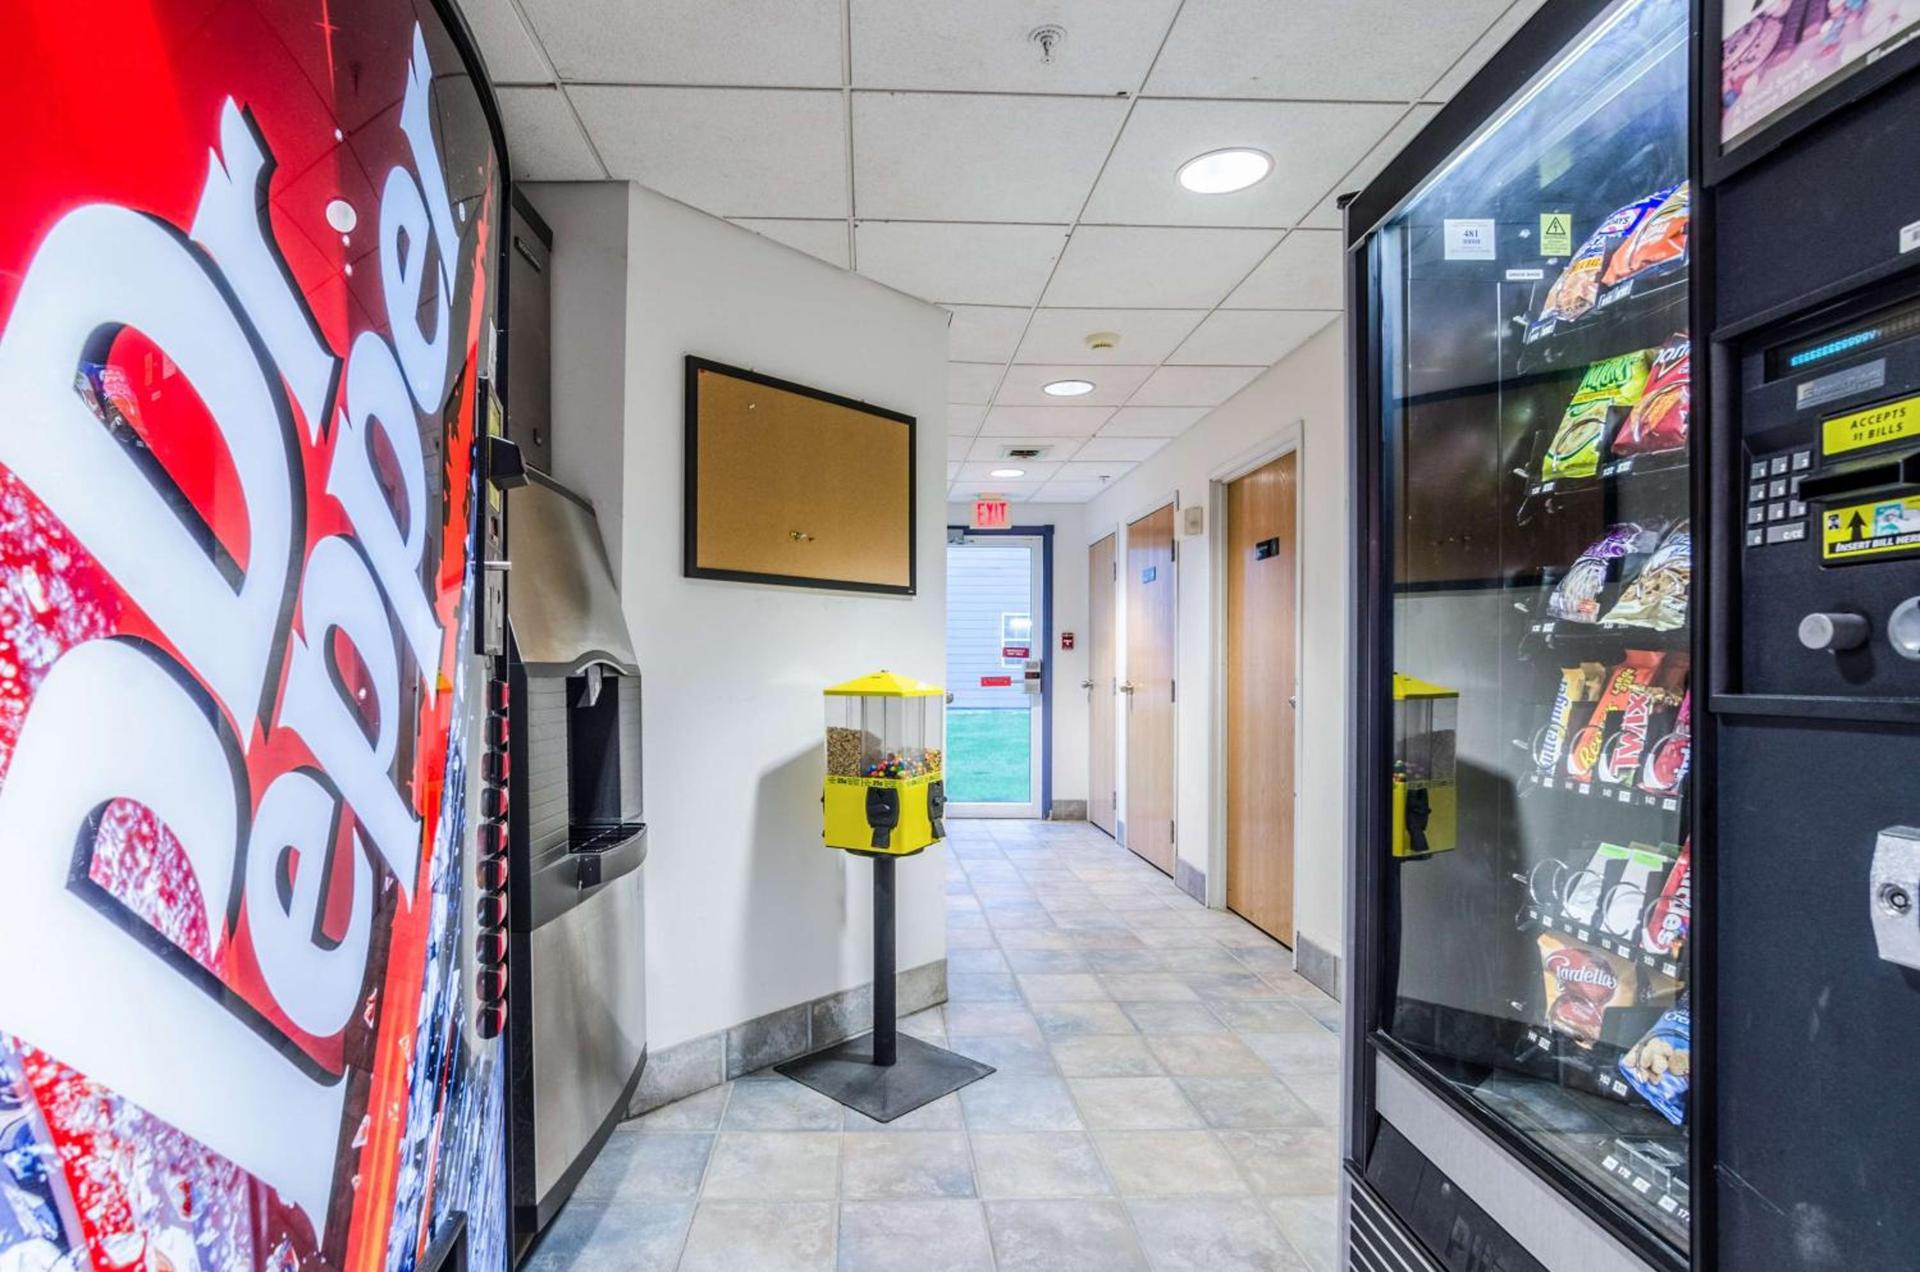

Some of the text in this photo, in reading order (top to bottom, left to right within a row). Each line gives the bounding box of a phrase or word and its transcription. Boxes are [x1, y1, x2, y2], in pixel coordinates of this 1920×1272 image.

[2, 95, 341, 752] Dr
[1851, 407, 1906, 430] ACCEPTS
[1868, 422, 1903, 439] BILLS
[977, 502, 1008, 526] EXIT
[1835, 540, 1872, 552] INSERT
[1872, 536, 1896, 548] BILL
[0, 22, 465, 1252] Pepper
[1609, 691, 1651, 777] TWIX
